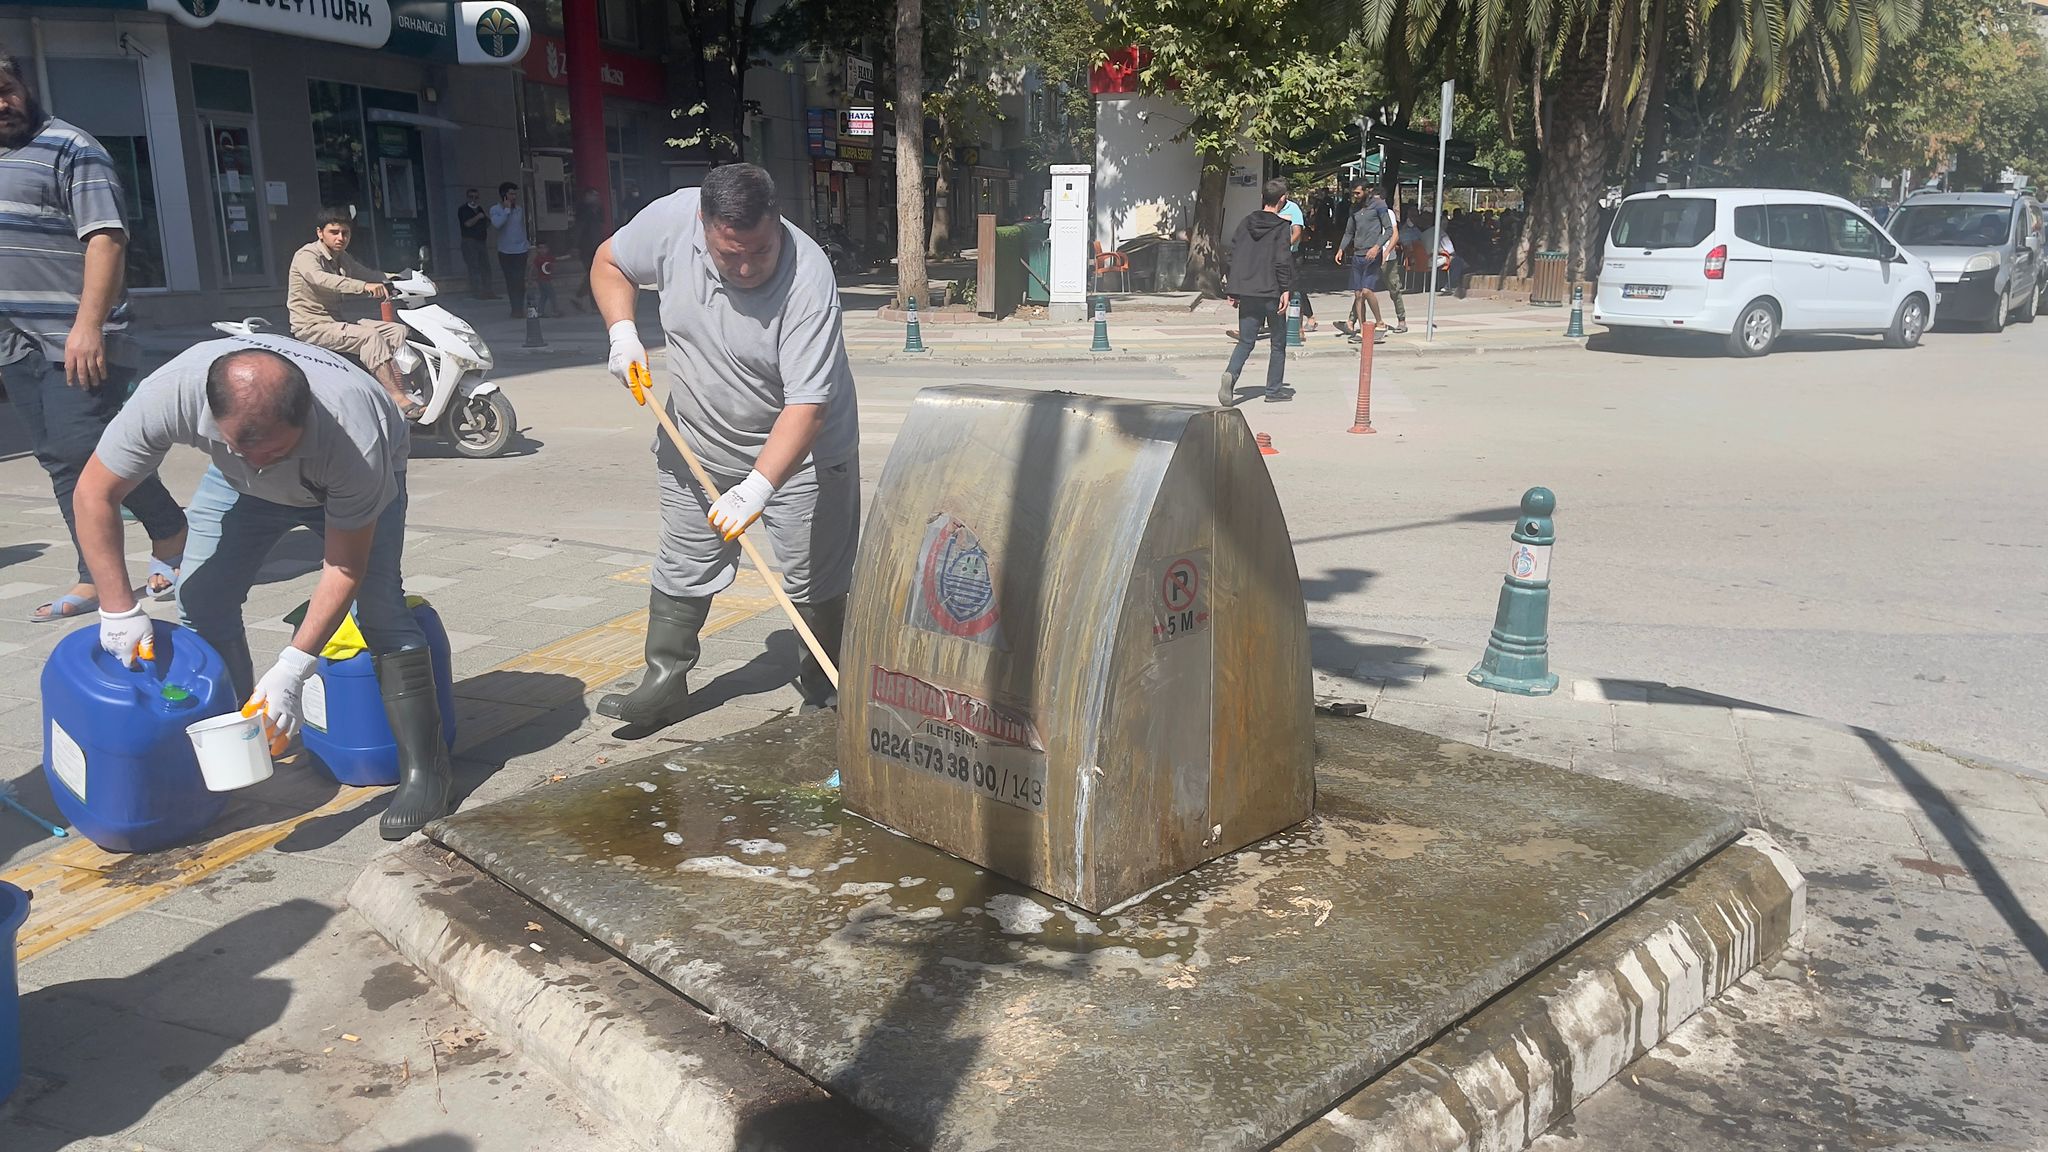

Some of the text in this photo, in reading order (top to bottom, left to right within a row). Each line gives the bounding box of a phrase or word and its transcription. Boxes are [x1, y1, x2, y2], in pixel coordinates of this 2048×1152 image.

[398, 15, 448, 37] ORHANGAZİ
[1167, 610, 1193, 635] 5 M
[926, 722, 978, 749] İLETİŞİM:
[870, 727, 911, 763] 0224
[913, 742, 944, 774] 573
[947, 752, 970, 783] 38
